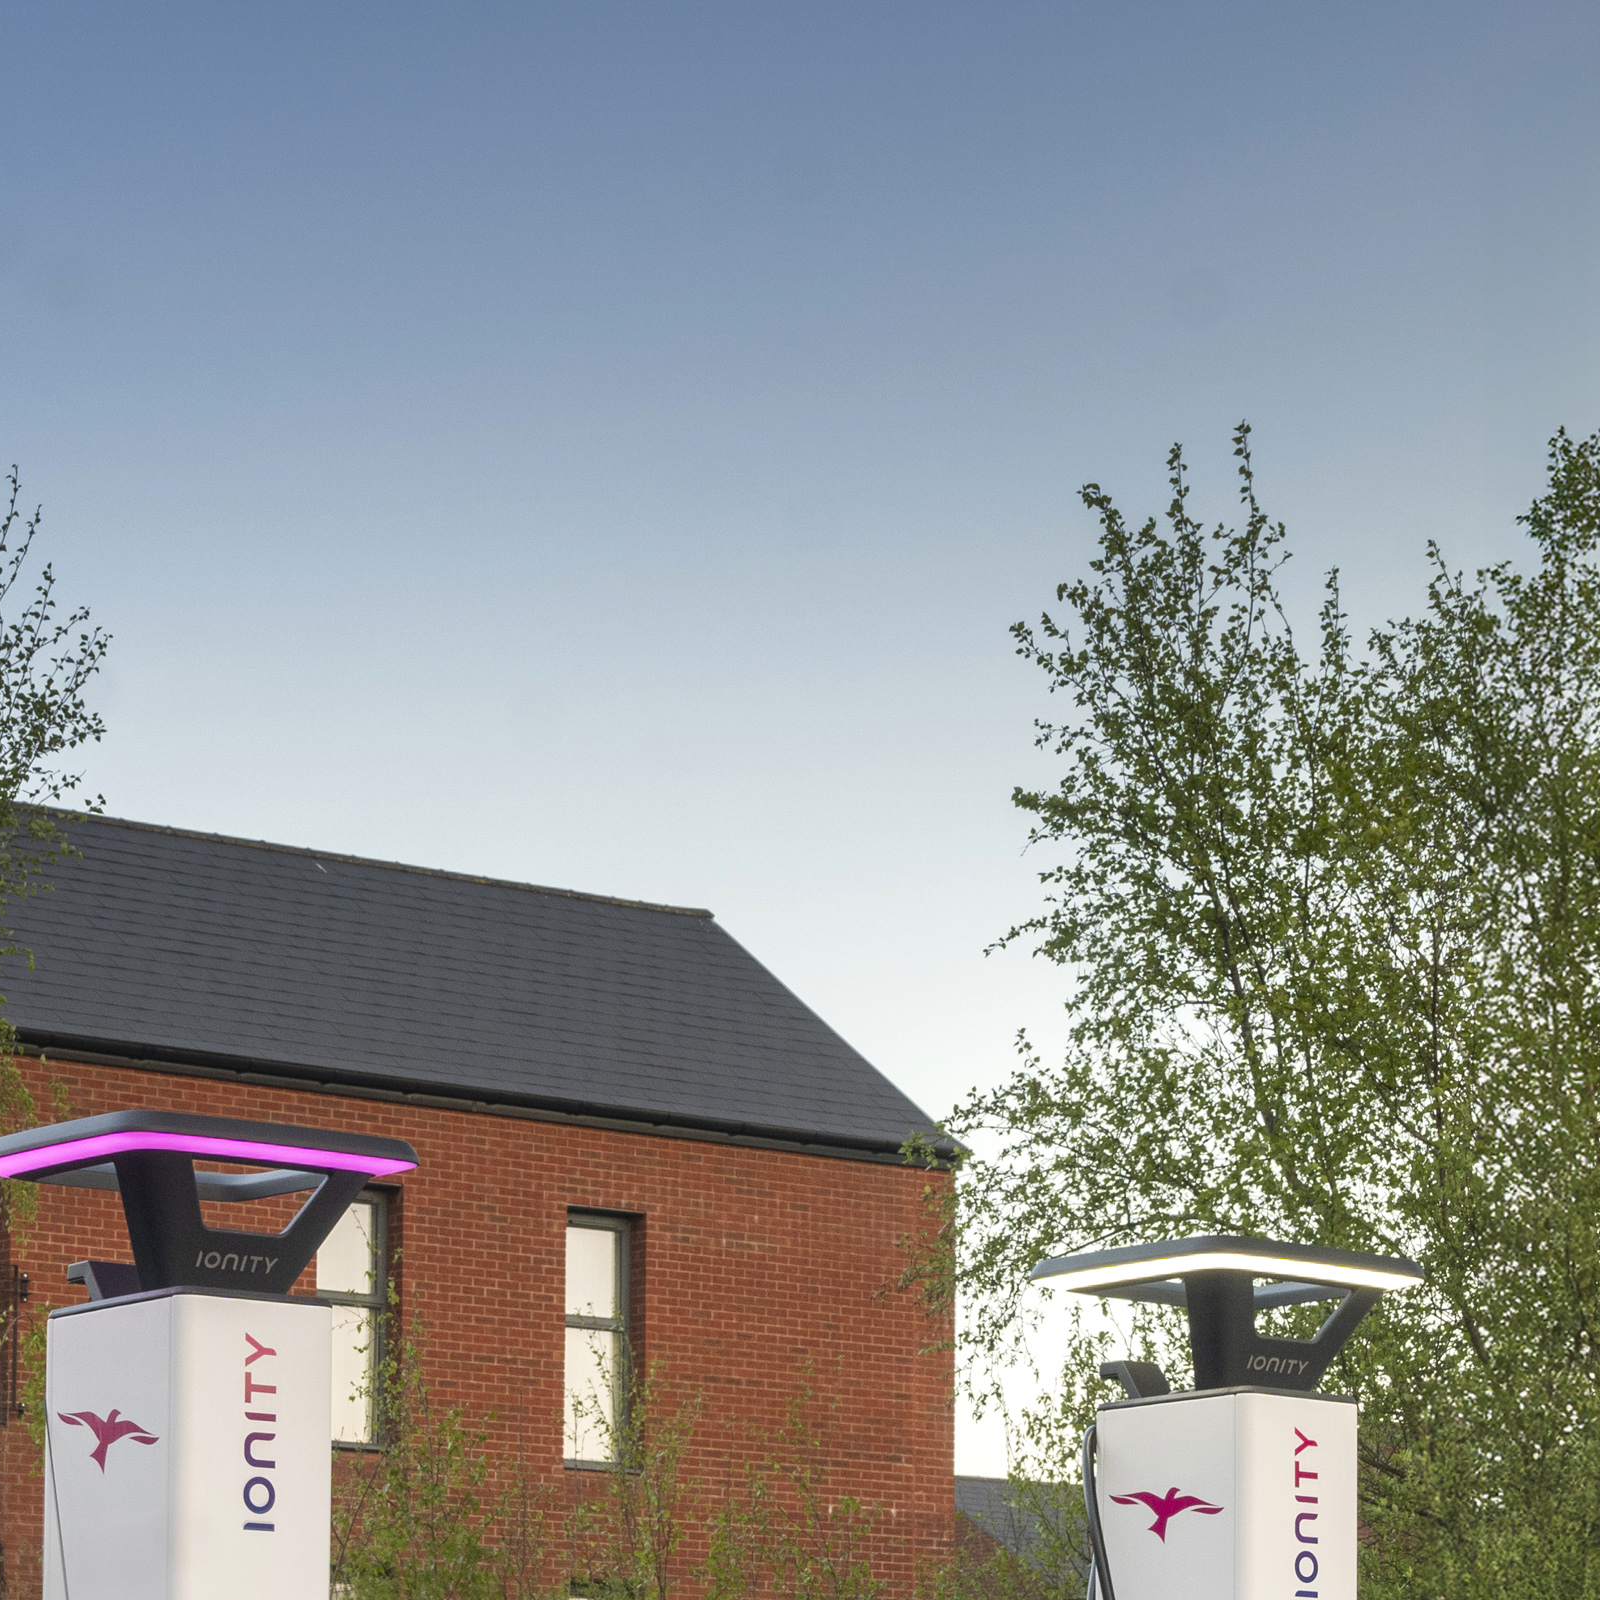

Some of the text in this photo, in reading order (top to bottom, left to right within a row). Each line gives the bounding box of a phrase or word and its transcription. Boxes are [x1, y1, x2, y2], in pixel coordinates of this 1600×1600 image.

[195, 1250, 279, 1275] IONITY
[1246, 1355, 1310, 1376] IONITY
[243, 1332, 277, 1532] IONITY
[1294, 1426, 1319, 1599] IONITY
